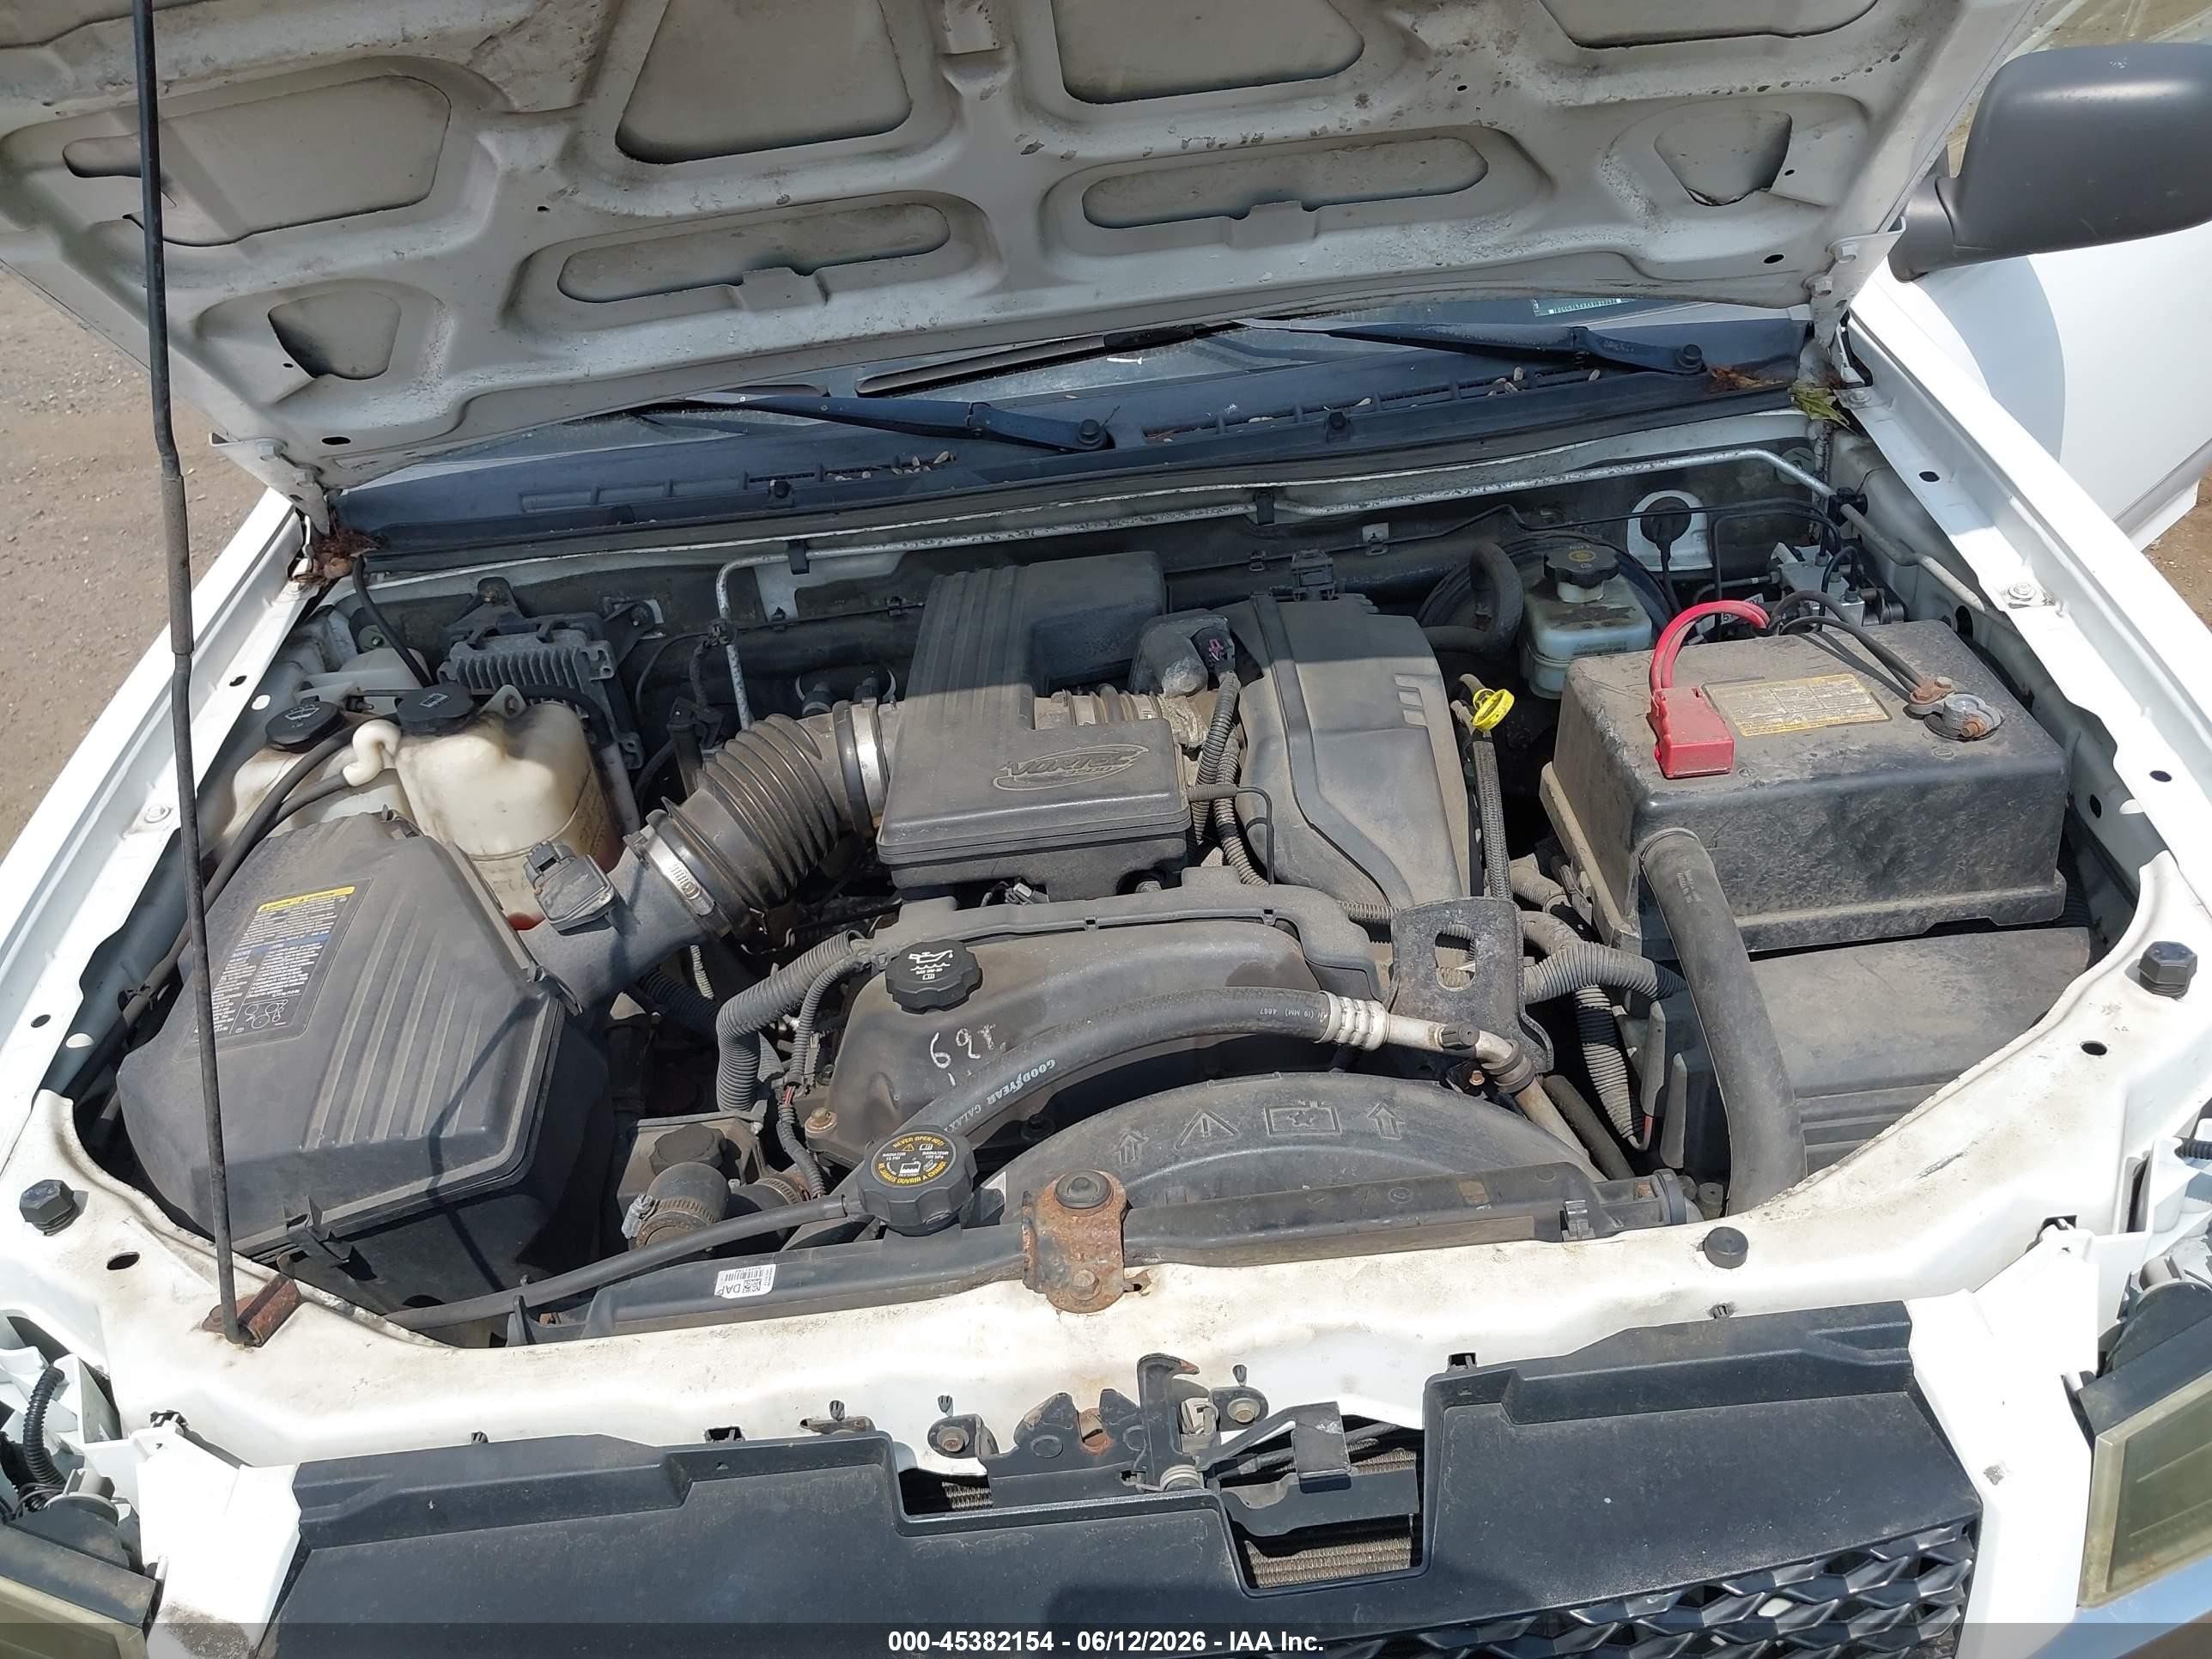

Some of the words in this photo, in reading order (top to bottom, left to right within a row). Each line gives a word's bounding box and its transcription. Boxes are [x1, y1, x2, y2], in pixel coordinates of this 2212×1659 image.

[987, 1059, 1055, 1105] GOODYEAR
[893, 1137, 914, 1148] NEVER
[717, 1284, 741, 1295] DAP
